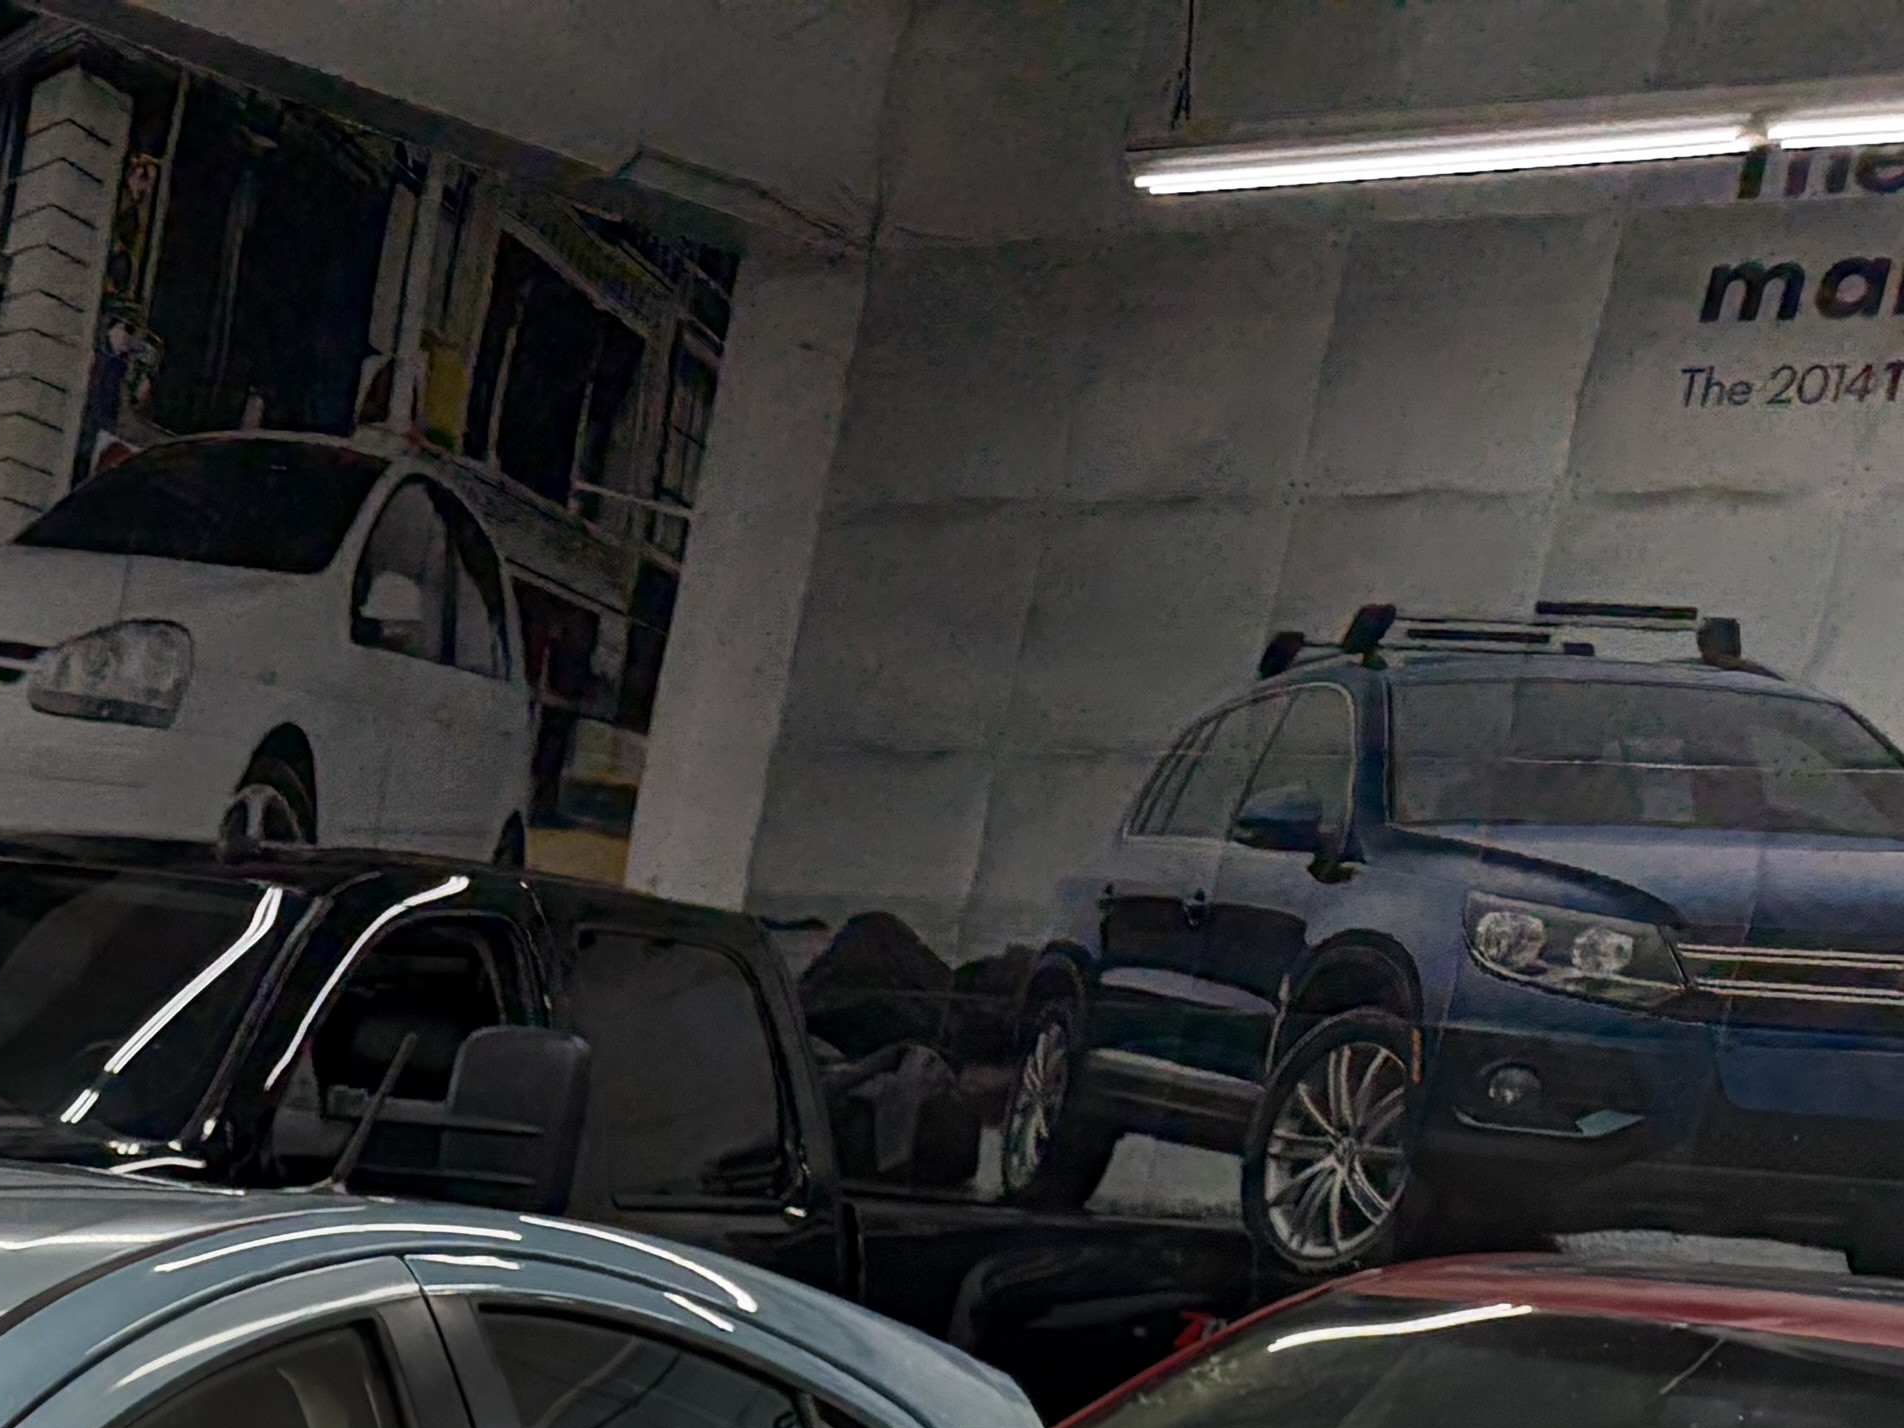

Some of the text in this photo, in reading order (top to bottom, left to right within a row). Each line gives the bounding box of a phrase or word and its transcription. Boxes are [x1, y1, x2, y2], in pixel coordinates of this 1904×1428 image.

[1699, 257, 1904, 323] ma
[1681, 366, 1752, 408] The
[1766, 364, 1873, 406] 2014
